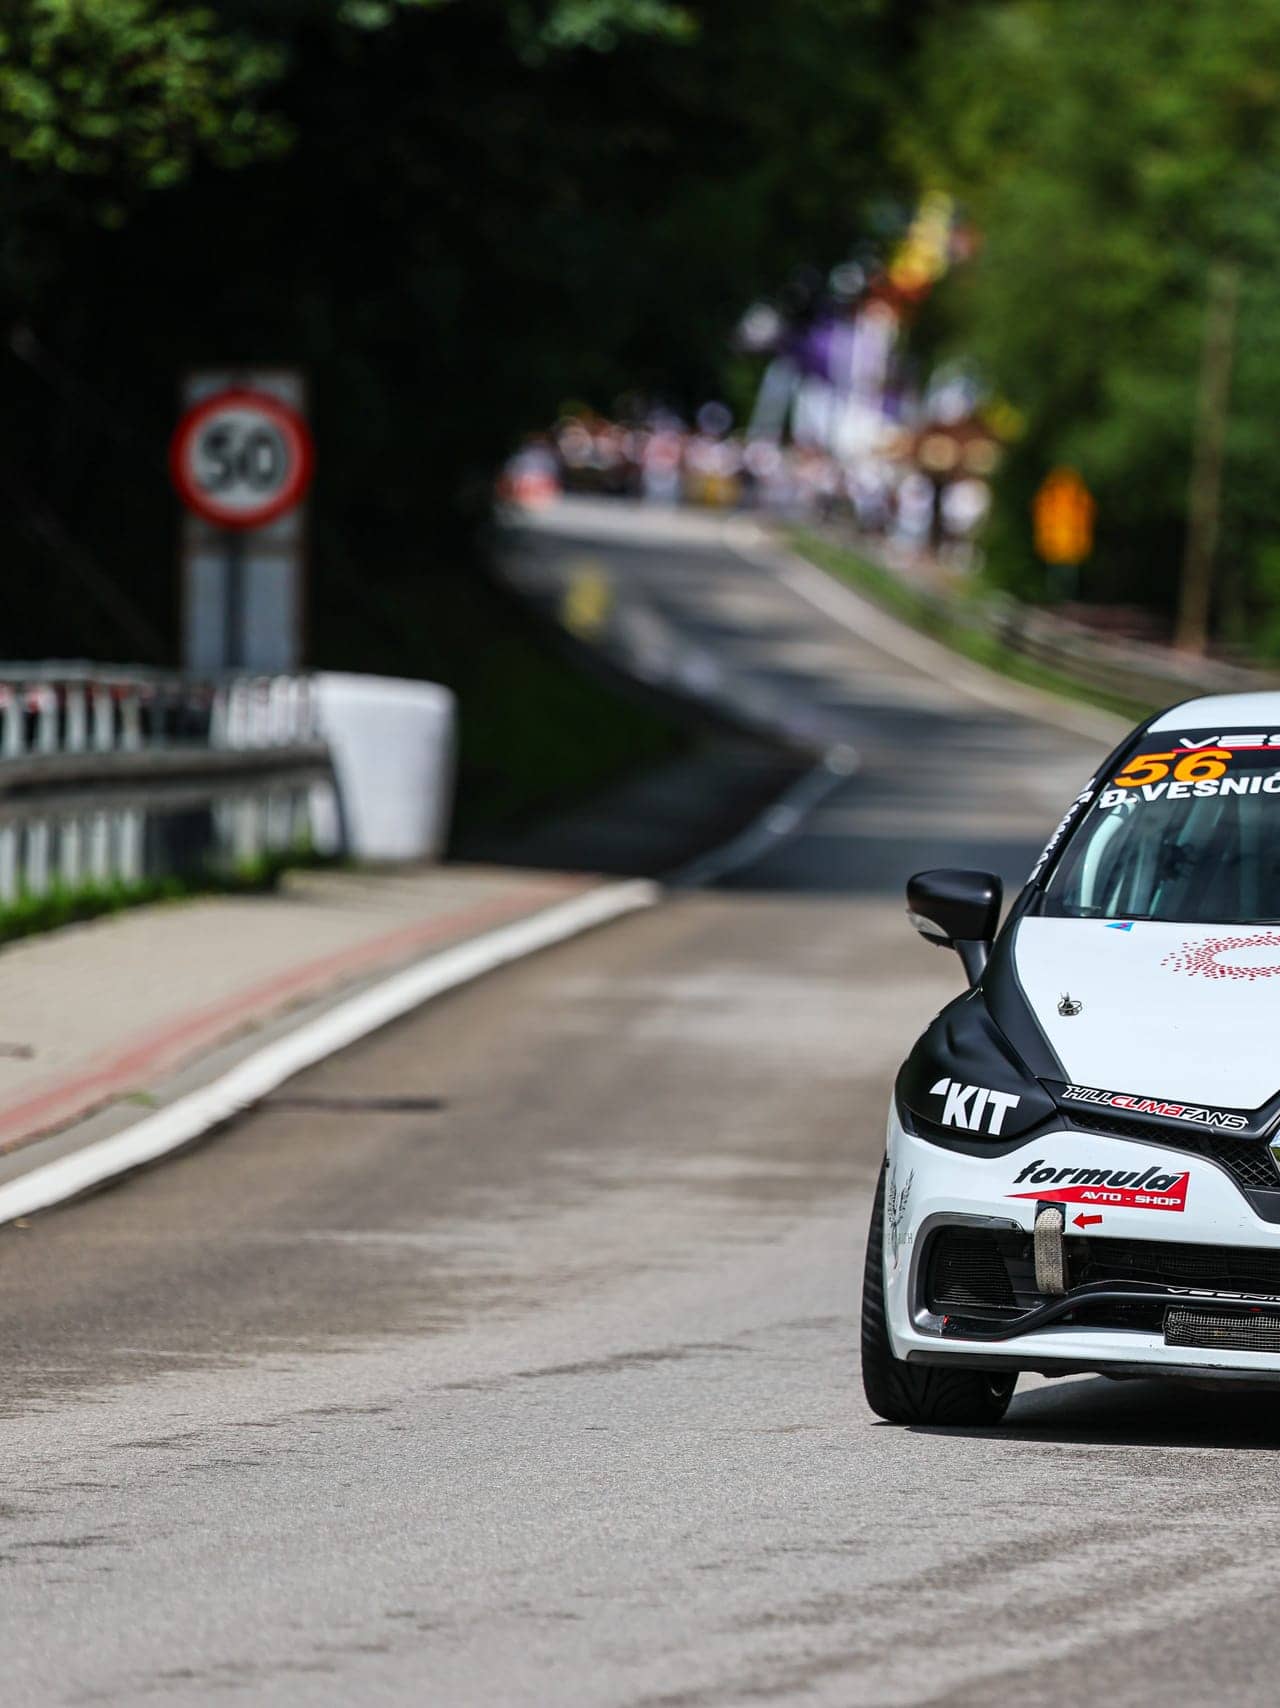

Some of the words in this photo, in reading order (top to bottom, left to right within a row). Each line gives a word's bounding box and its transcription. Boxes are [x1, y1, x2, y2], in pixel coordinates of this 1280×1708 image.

[202, 422, 286, 494] 50
[1113, 750, 1233, 787] 56
[1013, 1159, 1182, 1191] formula
[1080, 1191, 1122, 1202] AVTO
[1134, 1195, 1182, 1206] SHOP
